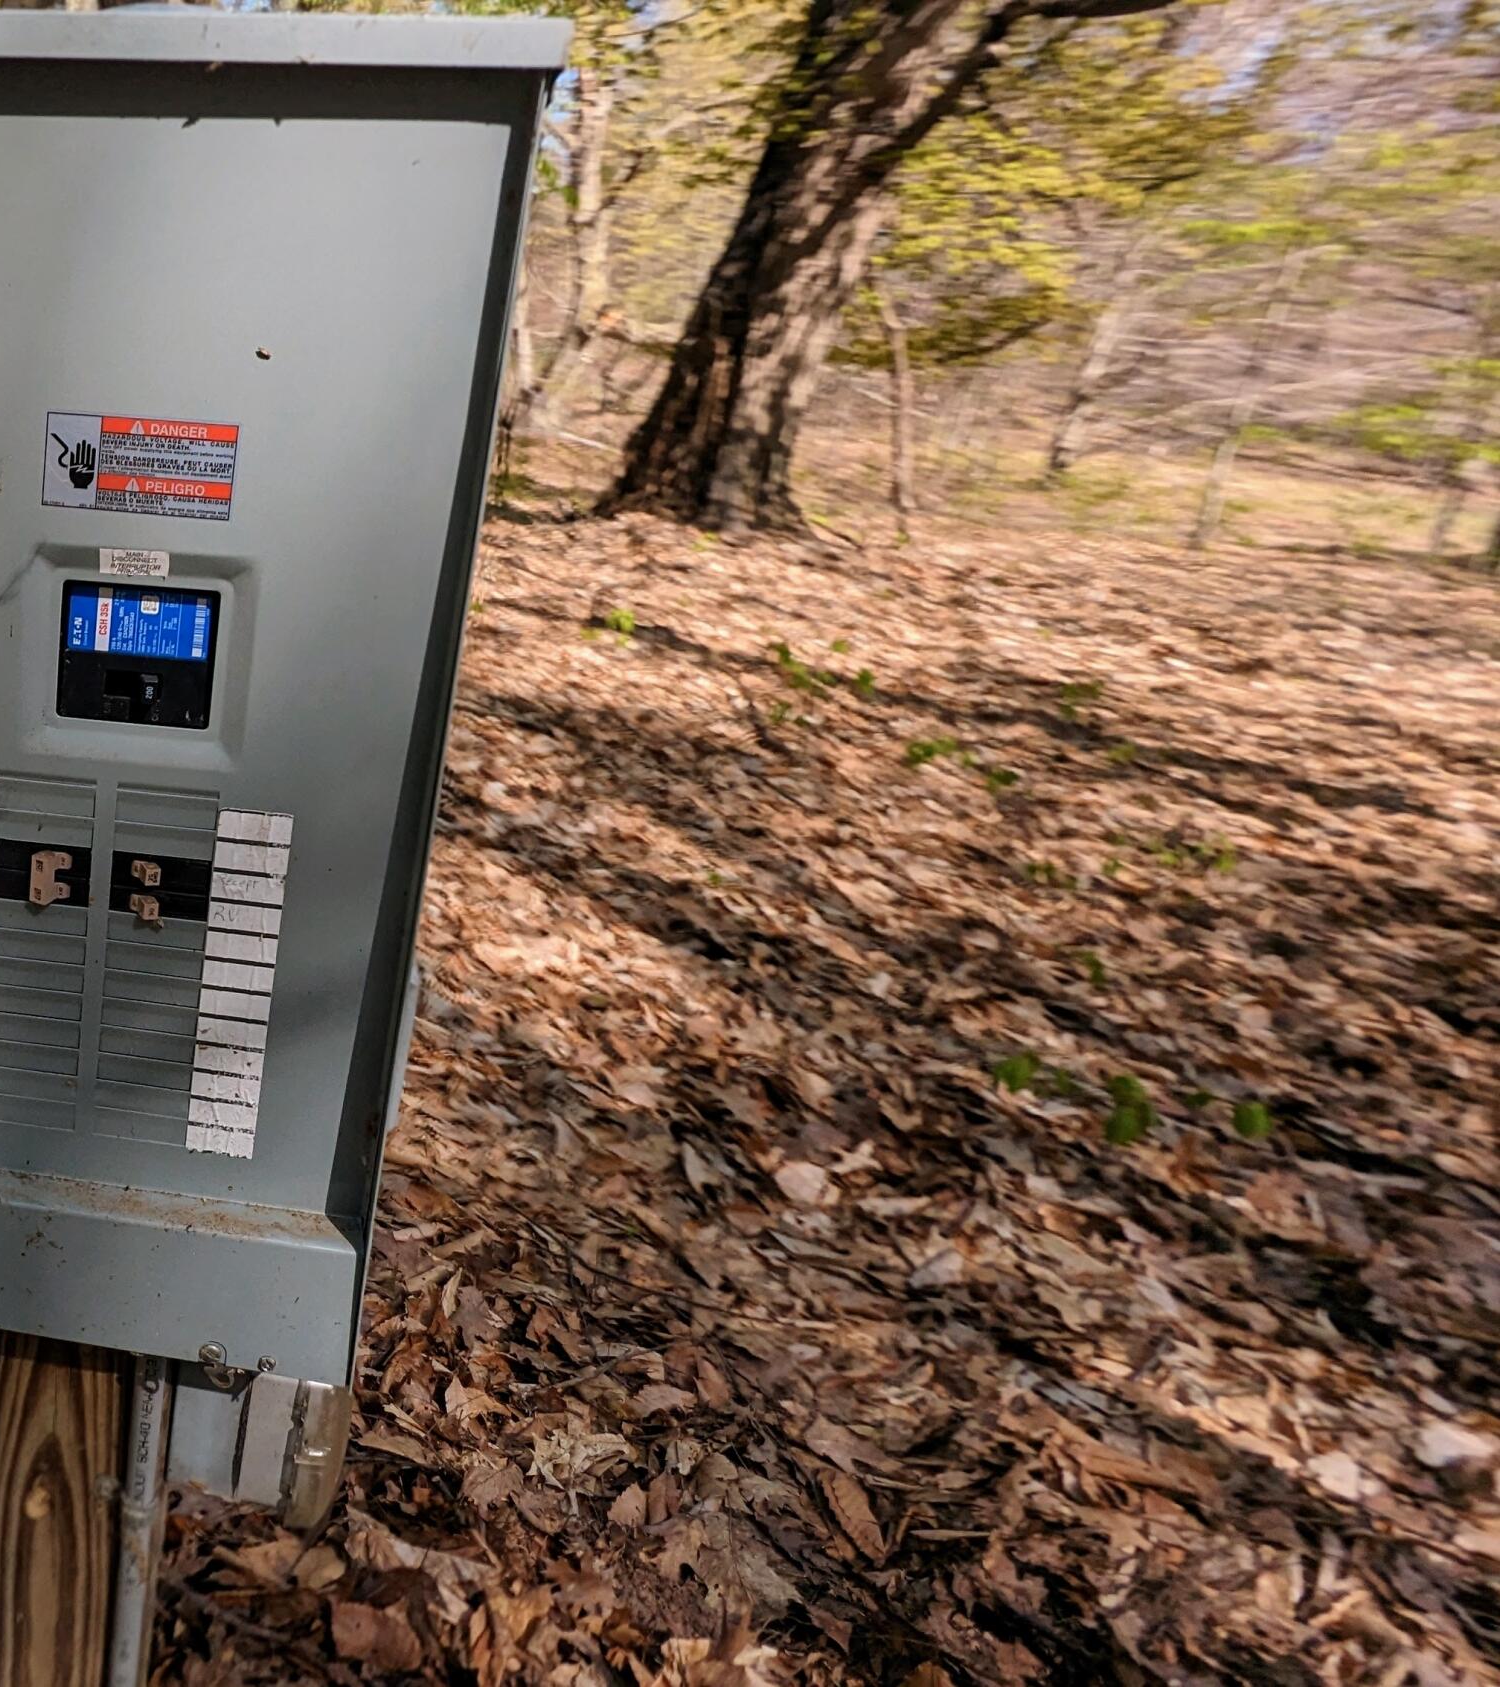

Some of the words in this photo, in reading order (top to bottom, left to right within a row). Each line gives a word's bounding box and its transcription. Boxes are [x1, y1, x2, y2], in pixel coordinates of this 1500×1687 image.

[102, 434, 146, 442] HAZARDOUS
[151, 424, 207, 438] DANGER
[102, 439, 127, 447] SEVERE
[115, 460, 155, 468] BLESSURES
[145, 481, 205, 496] PELIGRO
[97, 490, 126, 498] VOLTAJE
[198, 498, 229, 506] HERIDAS
[98, 619, 108, 636] CSH
[145, 686, 153, 699] 200
[136, 1422, 151, 1464] SCH-40
